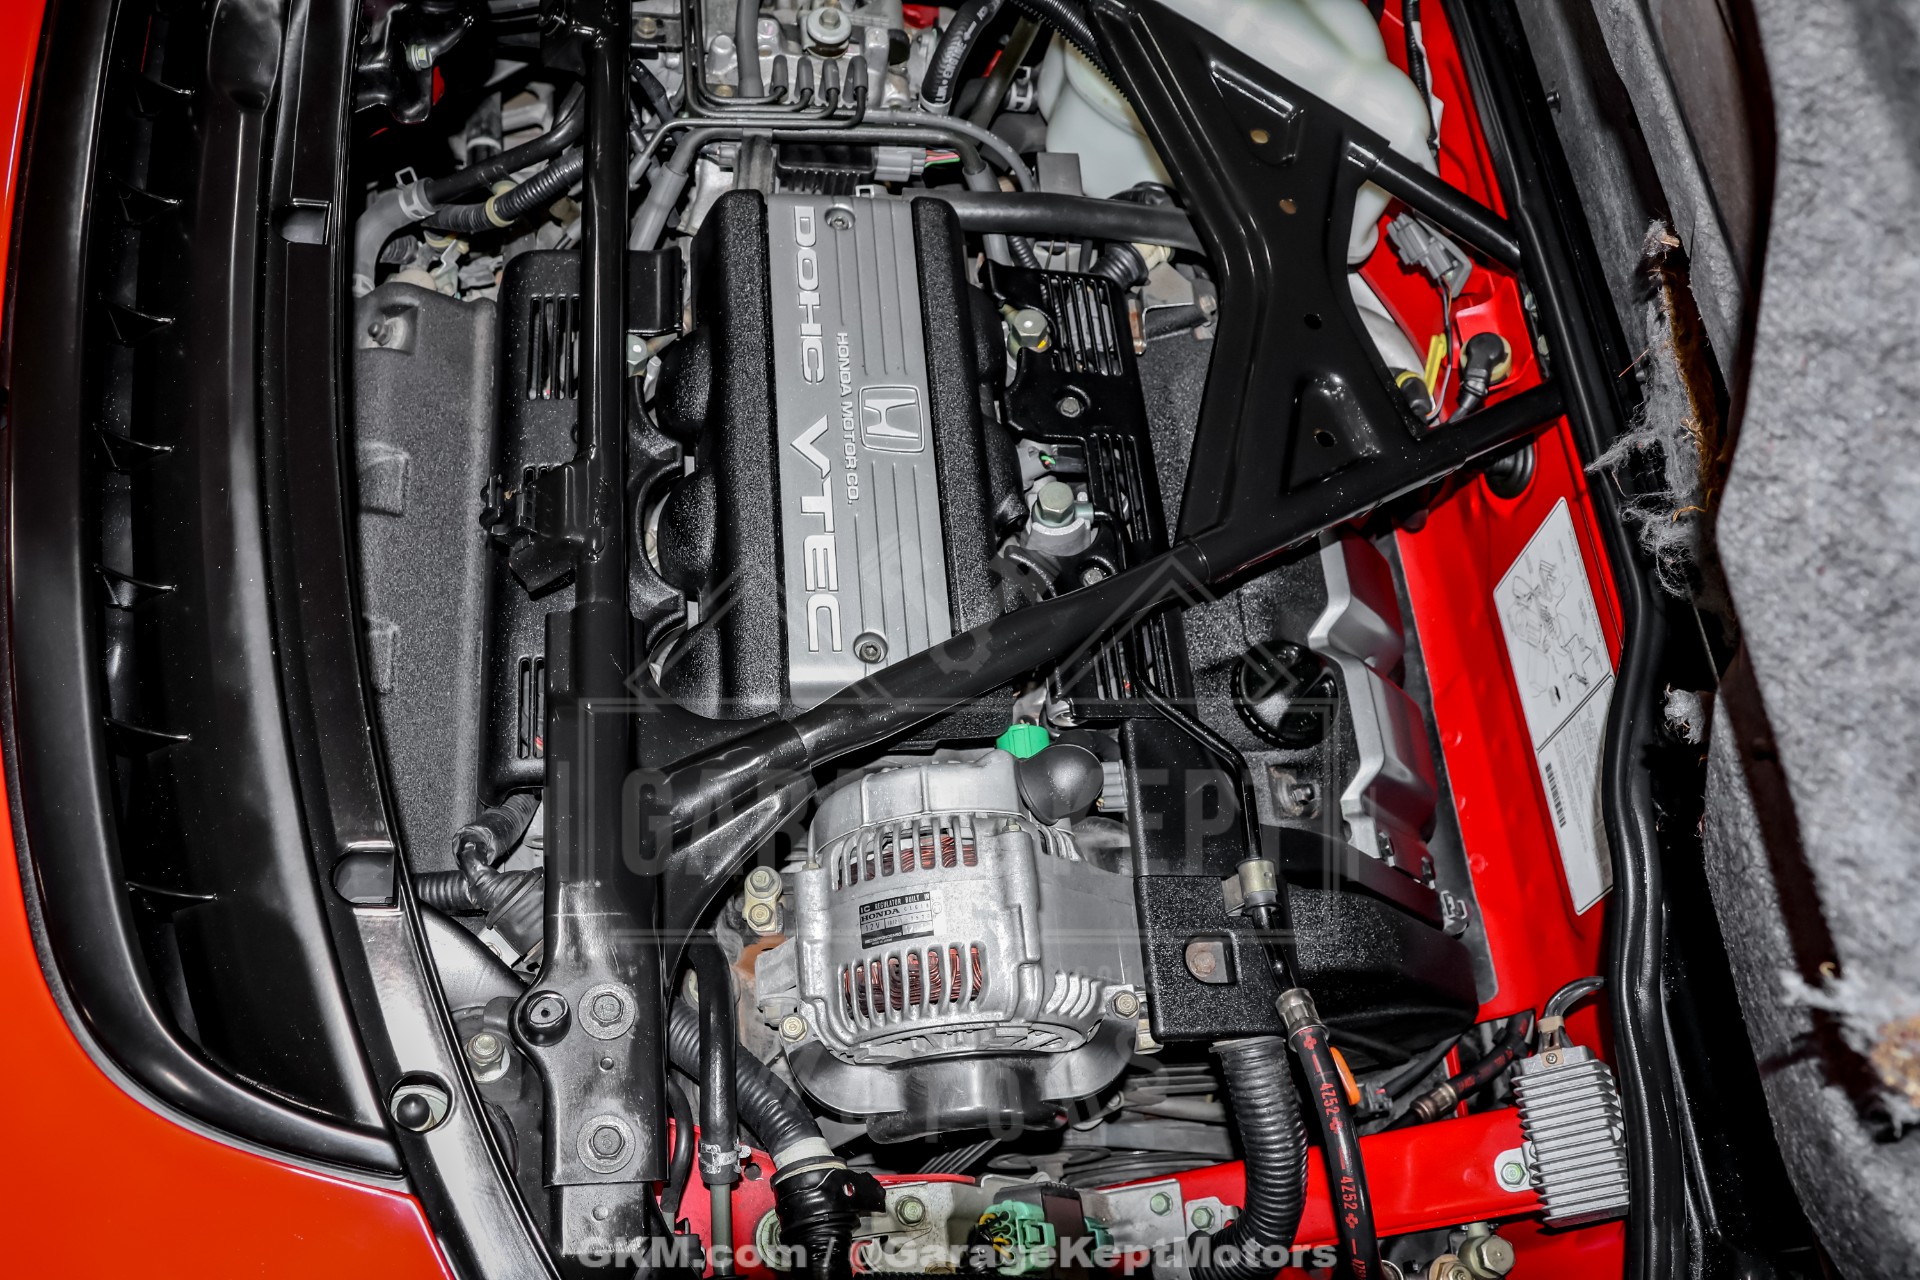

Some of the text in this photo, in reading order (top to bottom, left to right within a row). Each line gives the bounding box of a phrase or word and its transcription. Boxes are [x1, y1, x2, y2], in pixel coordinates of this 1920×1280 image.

[790, 206, 843, 653] DOHC VTEC
[836, 332, 860, 505] HONDA MOTOR CO.
[860, 905, 871, 914] IC
[874, 898, 902, 910] REGULATOR
[905, 894, 920, 904] BUILT
[860, 908, 900, 922] HONDA
